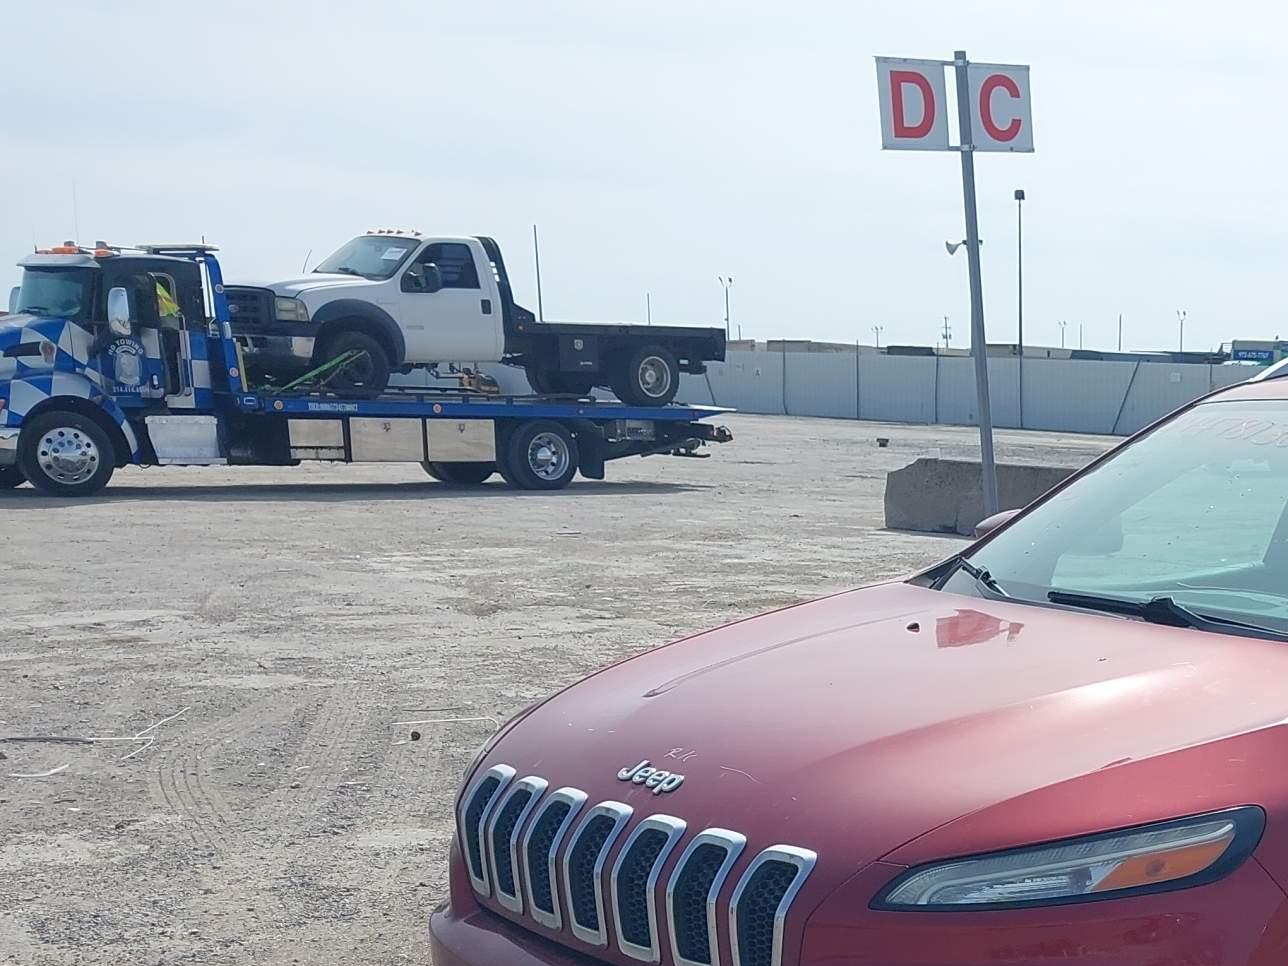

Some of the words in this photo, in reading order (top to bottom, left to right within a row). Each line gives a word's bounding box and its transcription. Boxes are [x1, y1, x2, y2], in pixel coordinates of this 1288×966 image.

[889, 70, 935, 138] D
[979, 74, 1022, 142] C
[617, 759, 685, 795] Jeep
